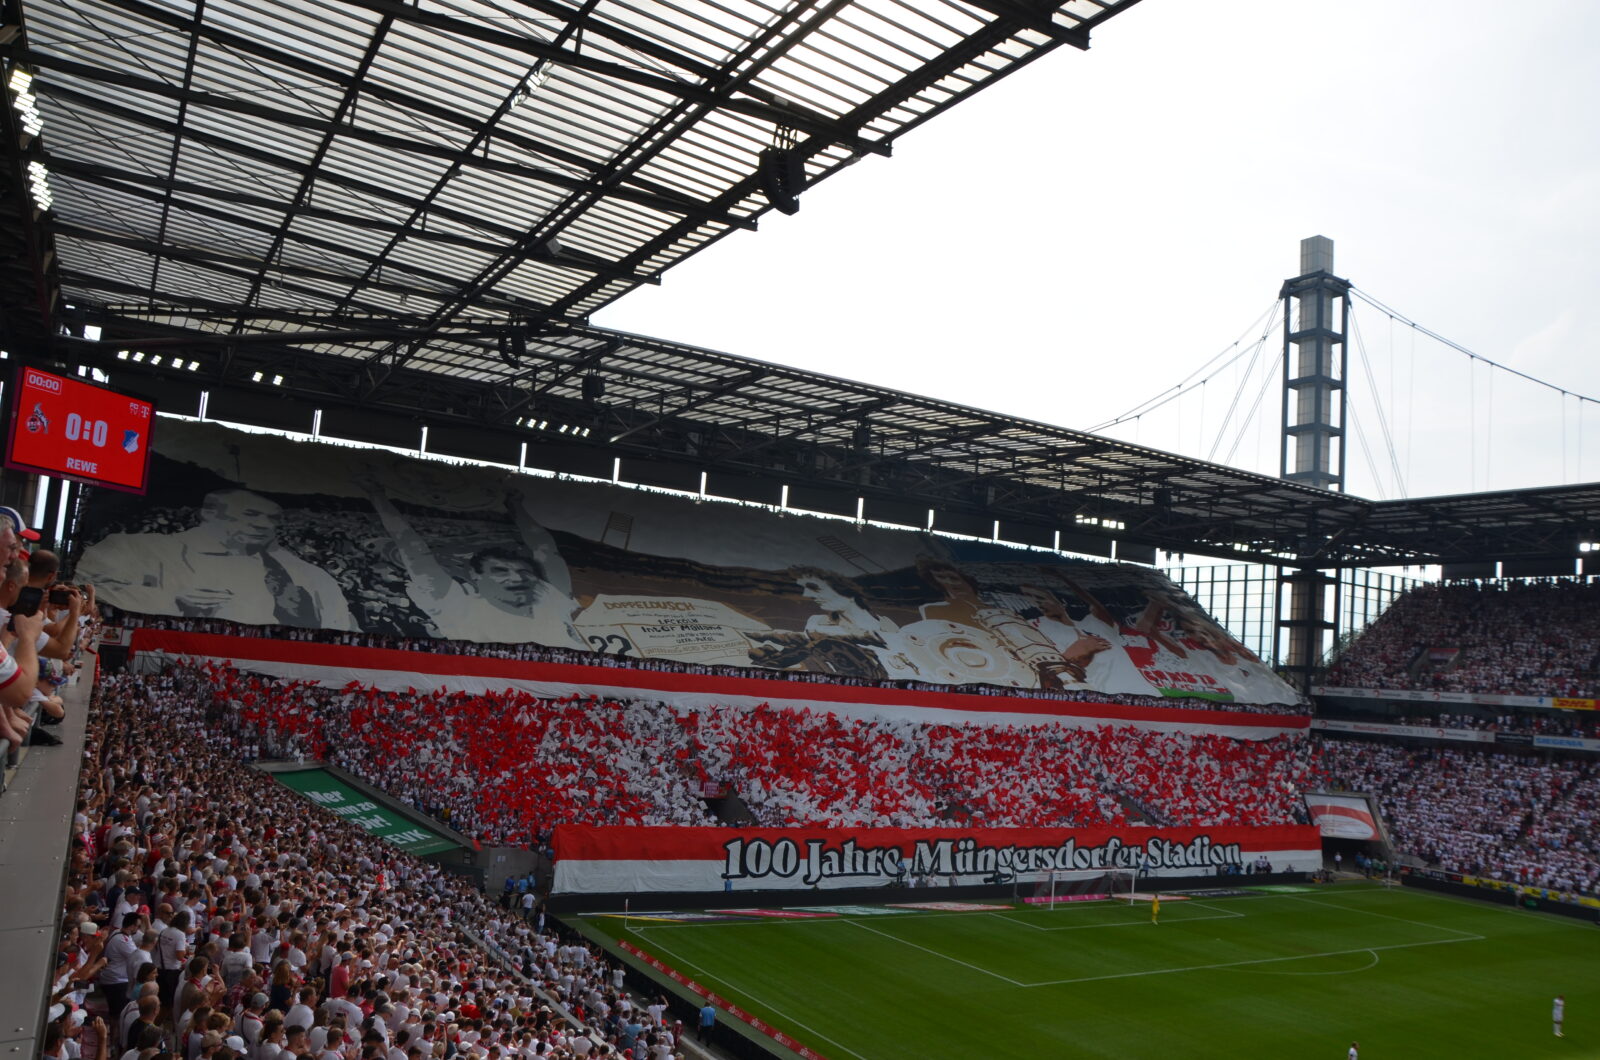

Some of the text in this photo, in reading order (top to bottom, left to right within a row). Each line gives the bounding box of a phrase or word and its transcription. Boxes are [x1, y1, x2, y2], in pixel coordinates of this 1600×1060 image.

[29, 374, 59, 391] 00:00
[65, 412, 108, 447] 0:0
[66, 457, 98, 474] REWE
[304, 791, 345, 803] Mer
[721, 835, 1242, 885] 100 Jahre Müngersdorfer Stadion
